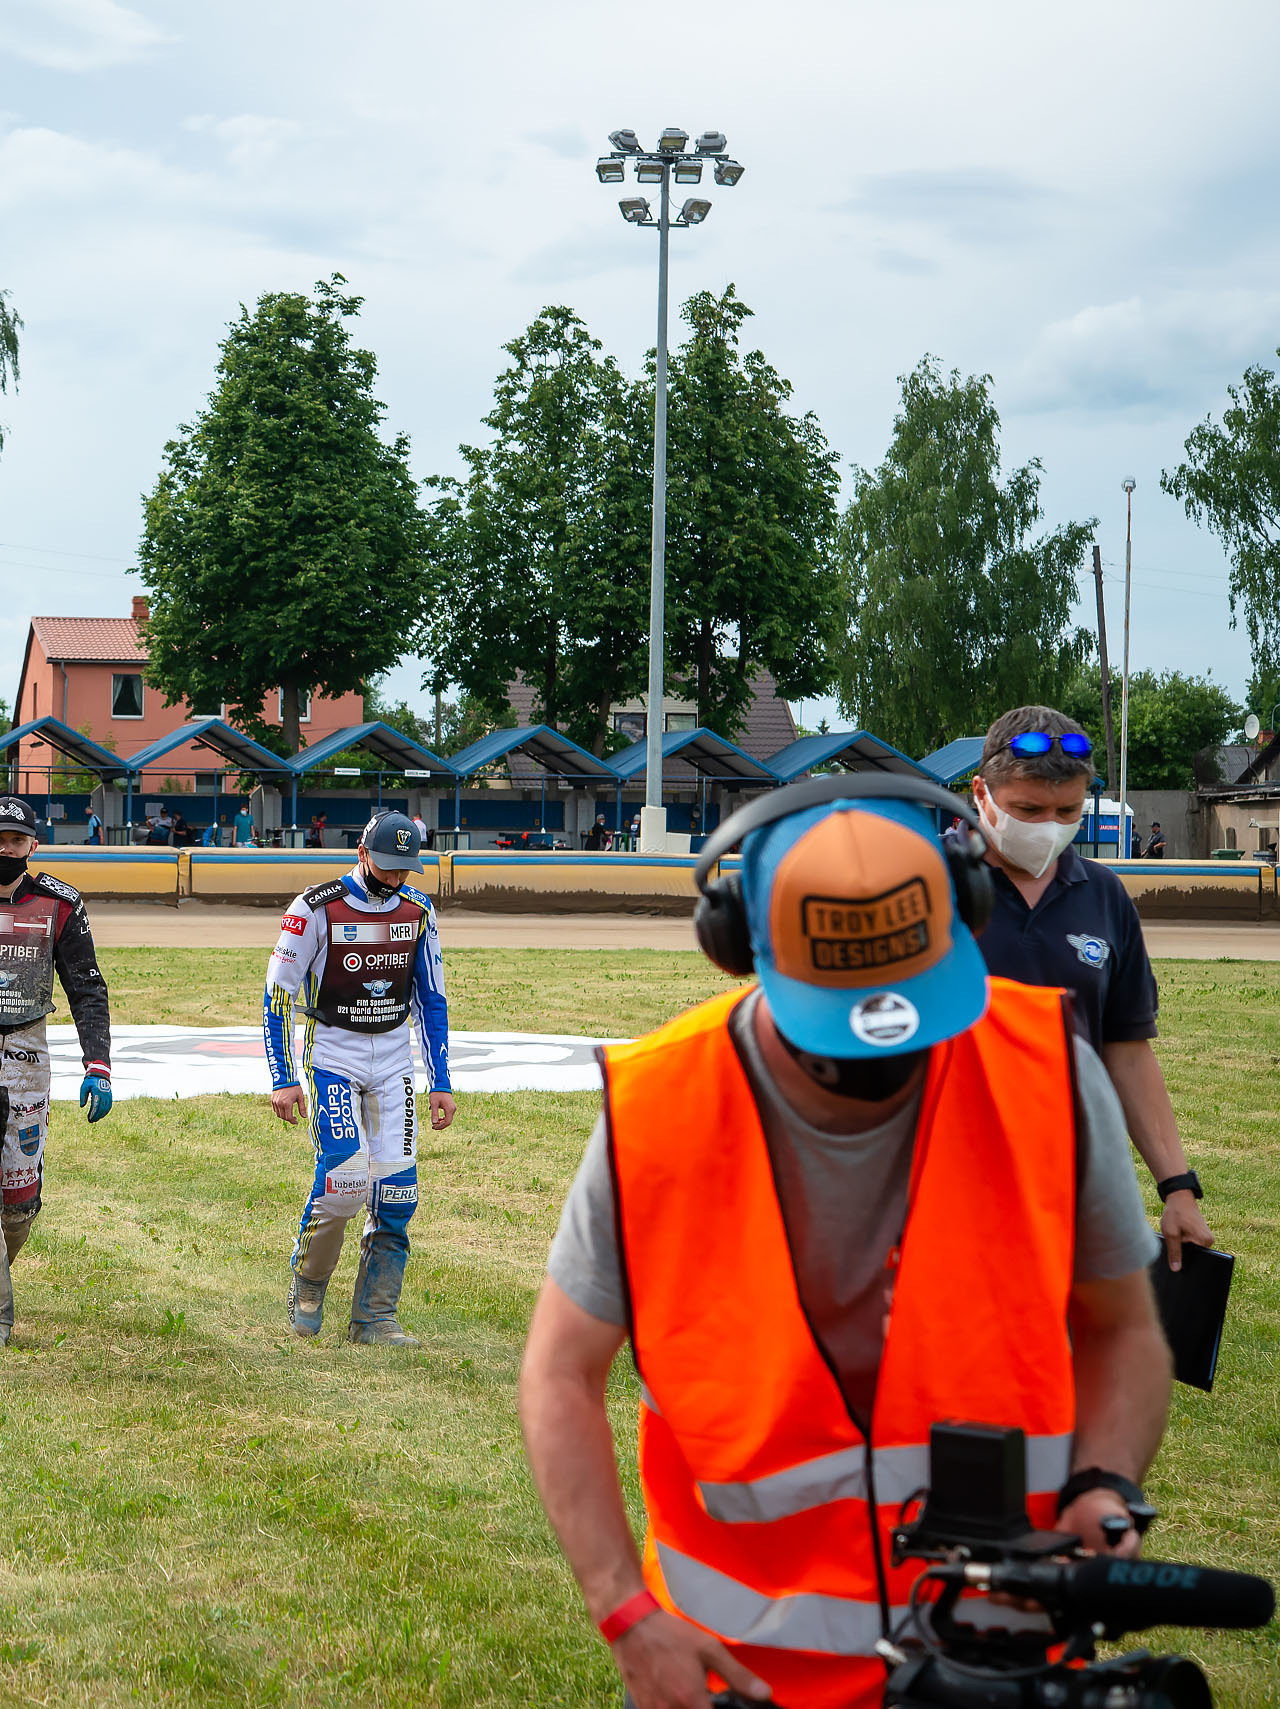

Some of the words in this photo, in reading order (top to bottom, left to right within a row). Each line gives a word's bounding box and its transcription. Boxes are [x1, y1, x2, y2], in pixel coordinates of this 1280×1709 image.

[308, 884, 342, 904] CANAL+
[815, 908, 878, 934] TROY
[883, 892, 921, 928] LEE
[390, 925, 411, 939] MFR
[814, 929, 921, 969] DESIGNS
[365, 952, 410, 967] OPTIBET
[3, 1005, 21, 1014] Round
[356, 999, 369, 1007] FIM
[369, 998, 396, 1007] Speedway
[337, 1005, 349, 1014] U21
[349, 1006, 372, 1015] World
[350, 1014, 382, 1024] Qualifying
[381, 1013, 396, 1022] Round
[0, 1173, 37, 1188] LATVIA
